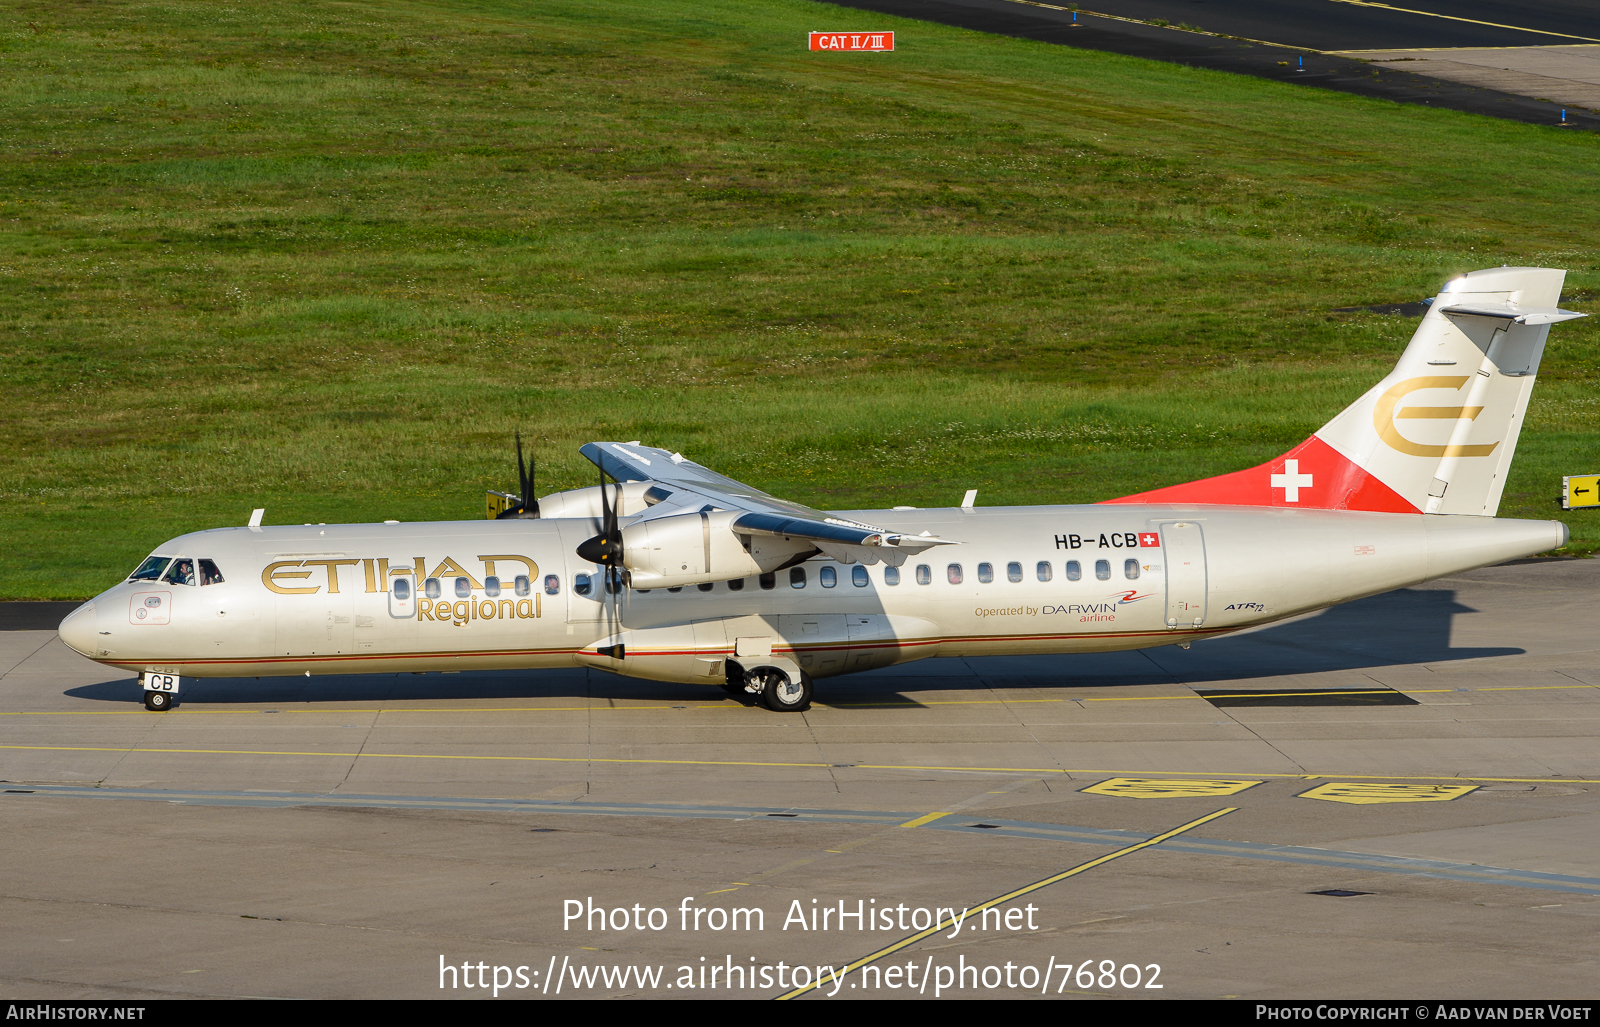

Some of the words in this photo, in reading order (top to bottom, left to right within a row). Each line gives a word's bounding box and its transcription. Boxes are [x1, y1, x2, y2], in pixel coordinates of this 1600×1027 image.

[819, 35, 847, 49] CAT
[850, 35, 884, 49] II/III
[1054, 533, 1138, 549] HB-ACB
[261, 555, 540, 594] ETIHAD
[417, 593, 542, 626] Regional
[974, 606, 1024, 618] Operated
[1026, 605, 1039, 616] by
[1042, 603, 1116, 615] DARWIN
[1079, 613, 1116, 622] airline
[151, 674, 174, 691] CB
